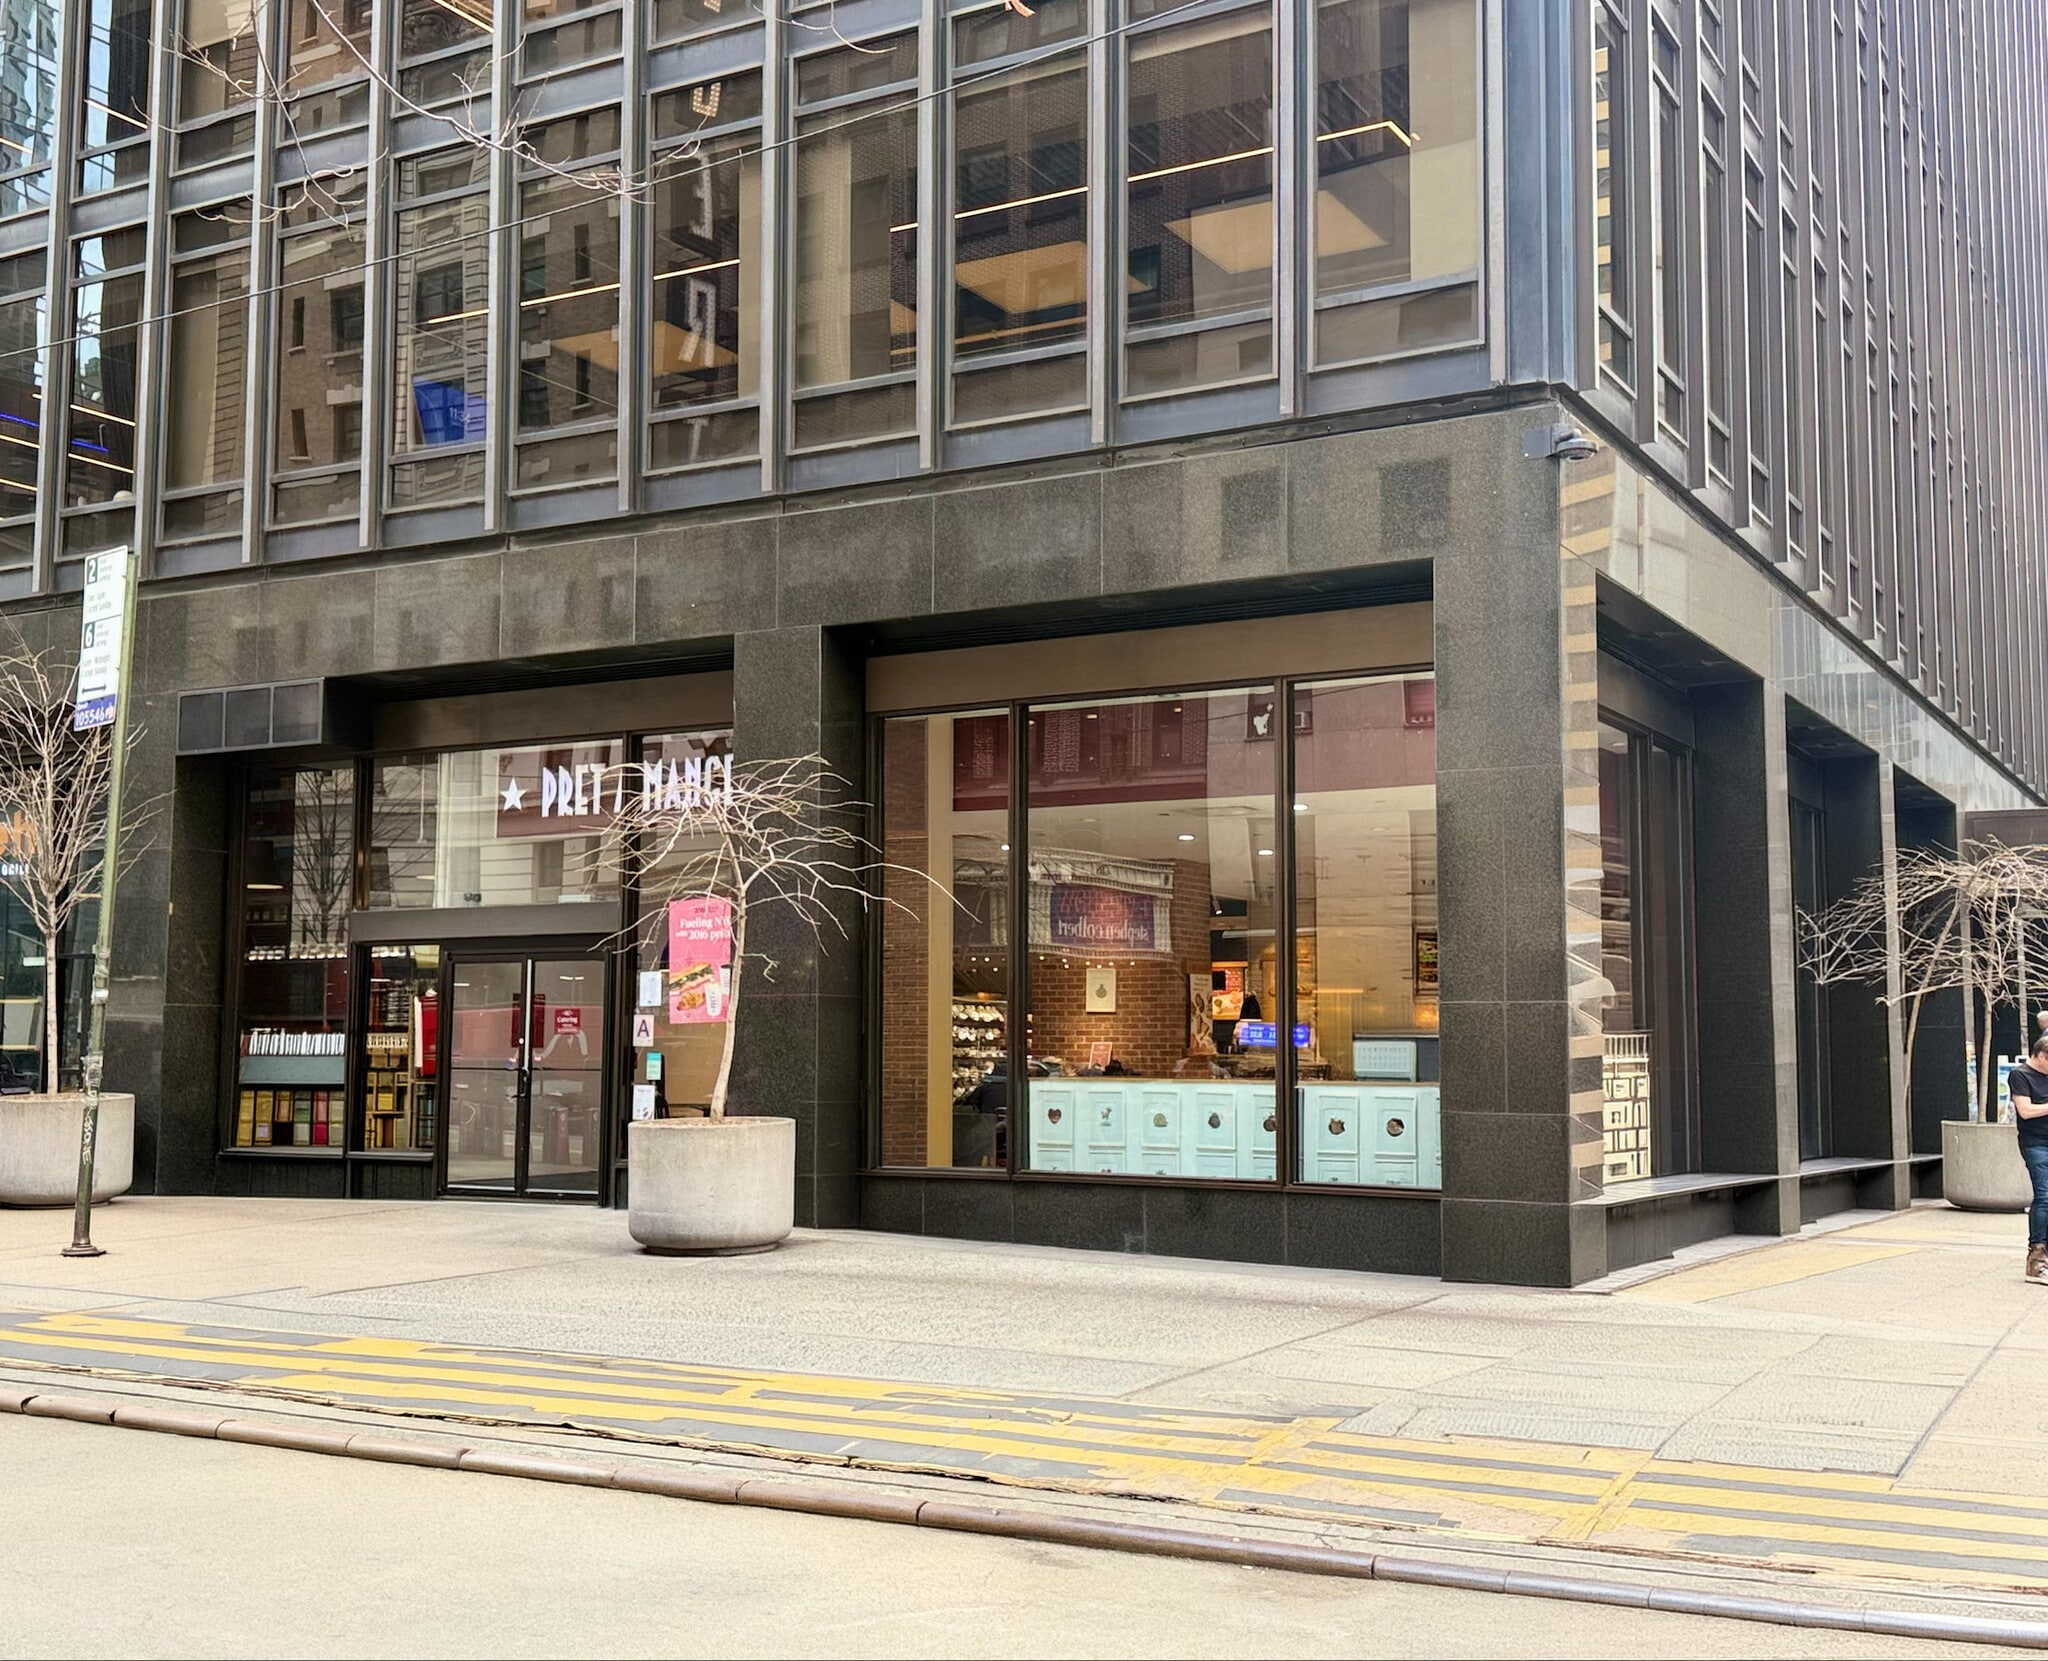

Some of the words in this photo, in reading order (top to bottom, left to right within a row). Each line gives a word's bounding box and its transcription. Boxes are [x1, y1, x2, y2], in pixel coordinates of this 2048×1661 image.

[88, 559, 96, 583] 2
[85, 623, 93, 648] 6
[541, 762, 606, 818] PRET
[680, 916, 713, 929] Fueling
[689, 929, 709, 941] 2016
[637, 1019, 650, 1038] A
